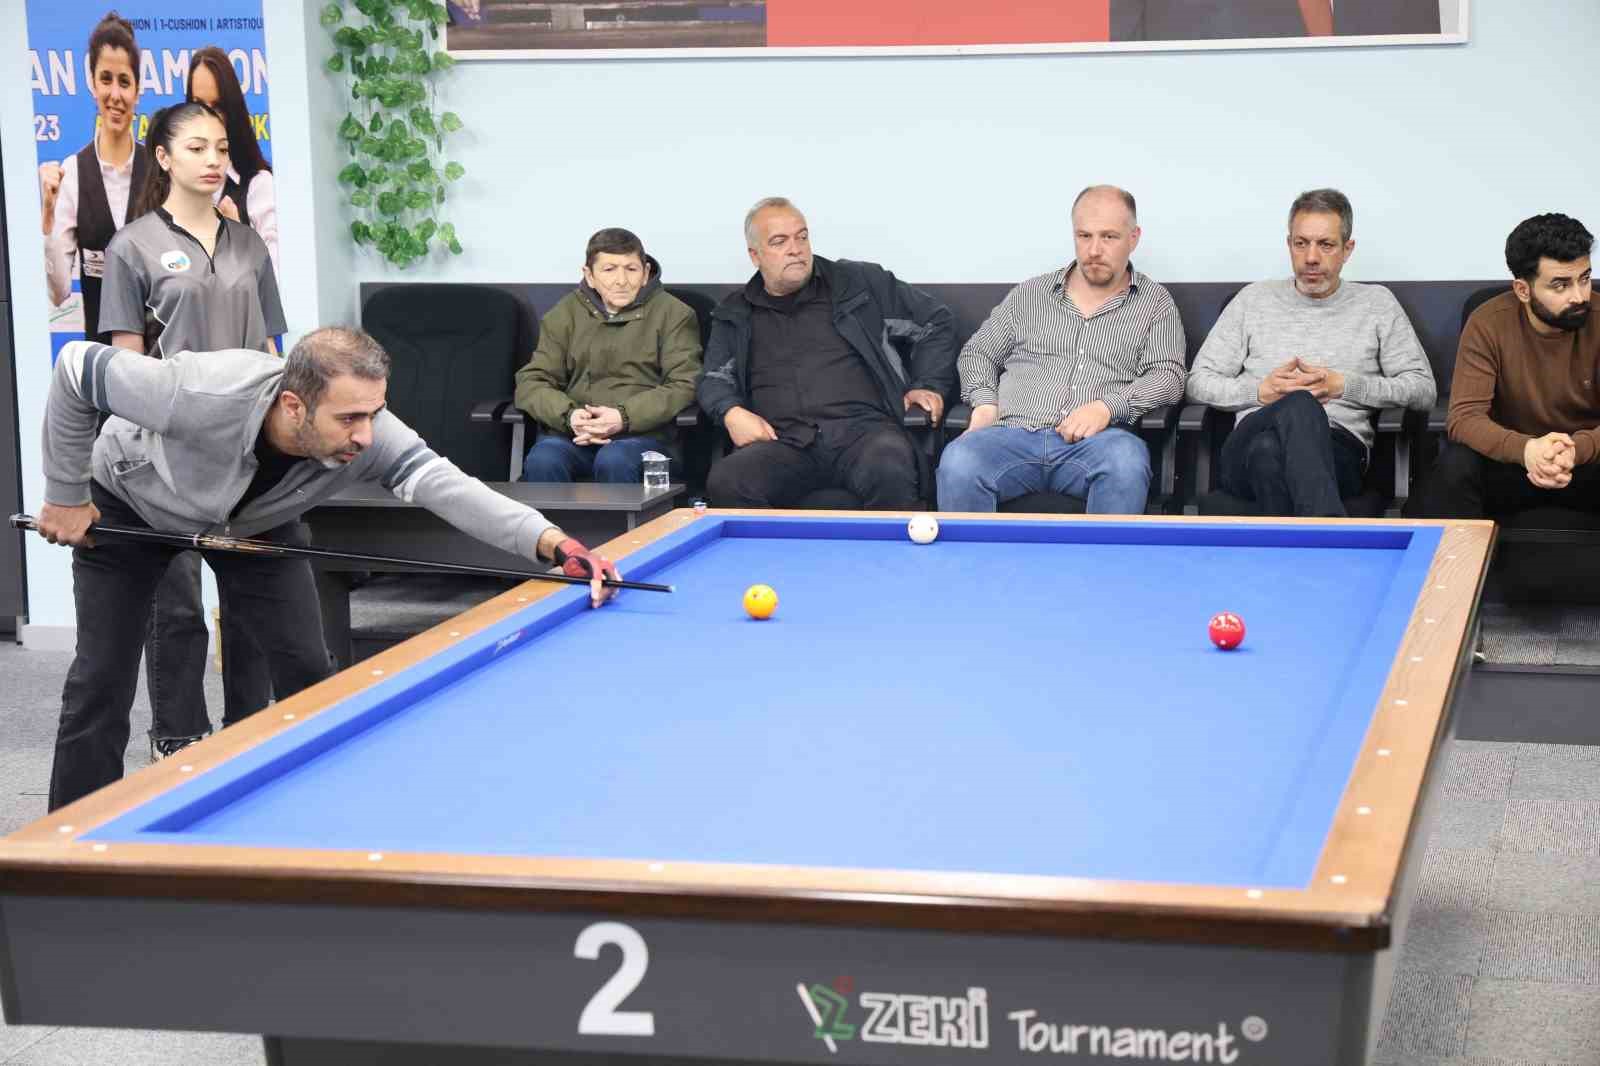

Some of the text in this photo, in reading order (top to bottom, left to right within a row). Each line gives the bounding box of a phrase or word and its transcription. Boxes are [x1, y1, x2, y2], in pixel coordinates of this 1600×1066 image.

[160, 18, 207, 31] 1-CUSHION
[574, 921, 655, 1036] 2
[1008, 1009, 1239, 1064] Tournament
